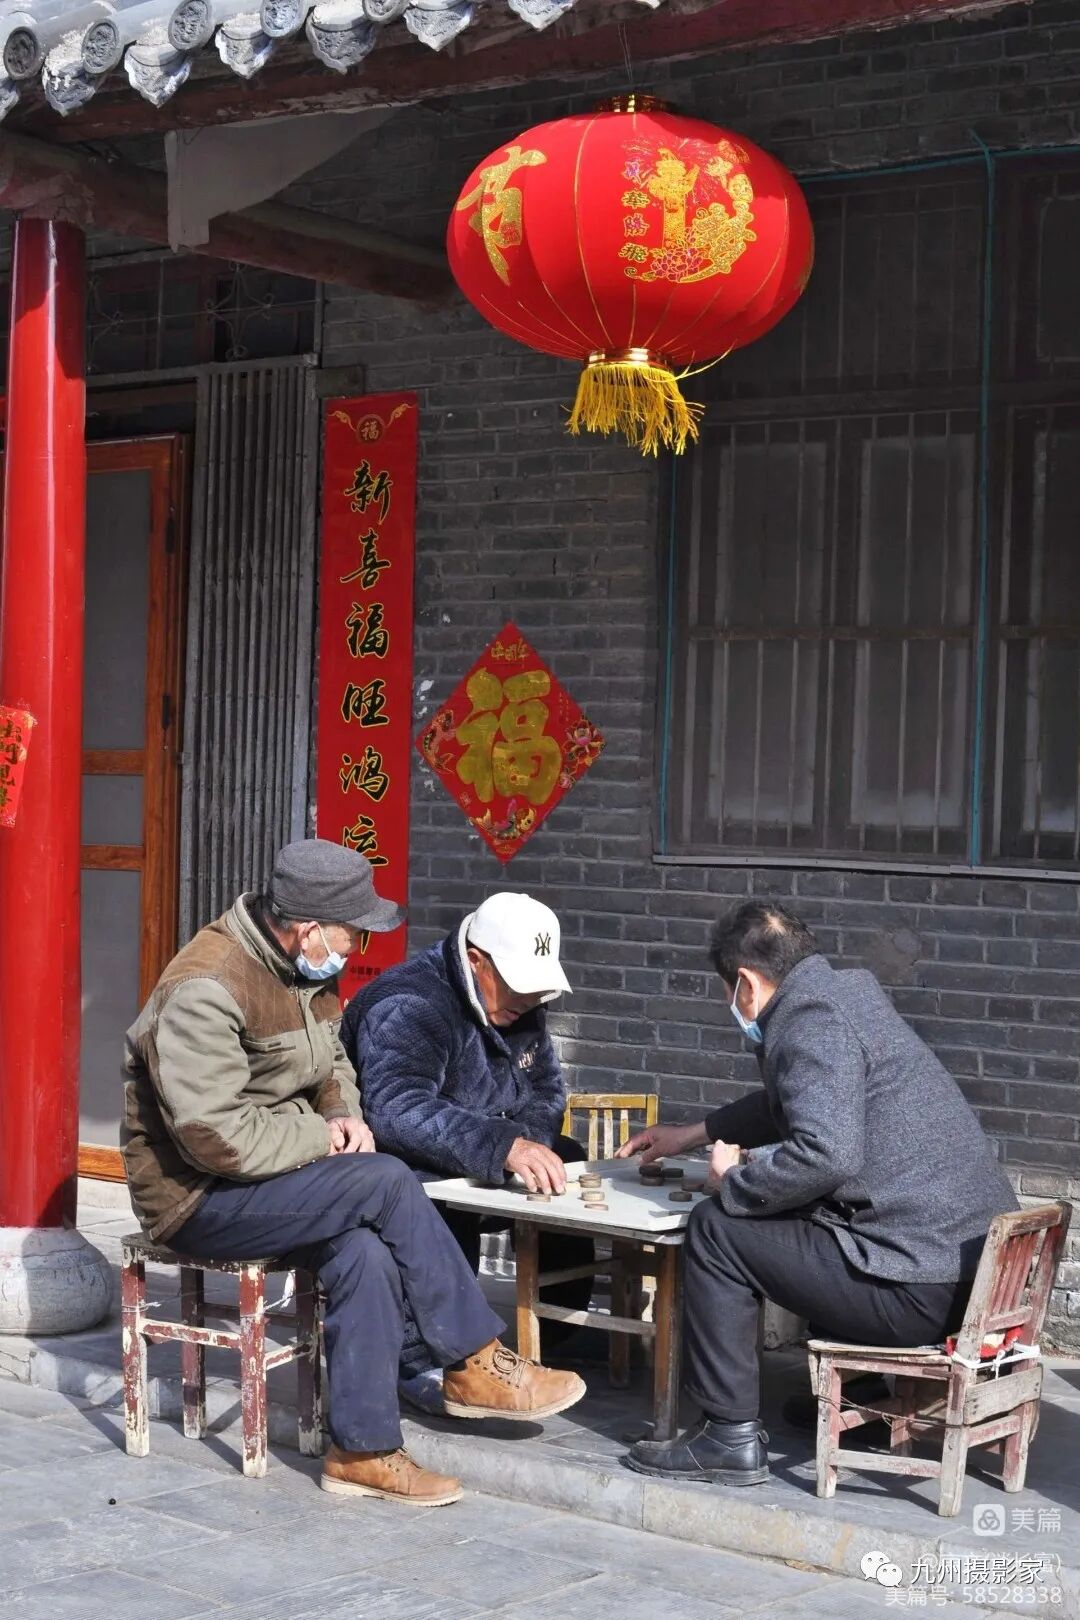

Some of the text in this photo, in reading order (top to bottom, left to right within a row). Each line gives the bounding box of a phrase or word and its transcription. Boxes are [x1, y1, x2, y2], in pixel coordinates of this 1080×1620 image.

[360, 420, 379, 441] 福
[339, 458, 393, 956] 新喜福旺鸿运
[455, 667, 562, 804] 福
[534, 932, 552, 956] NY
